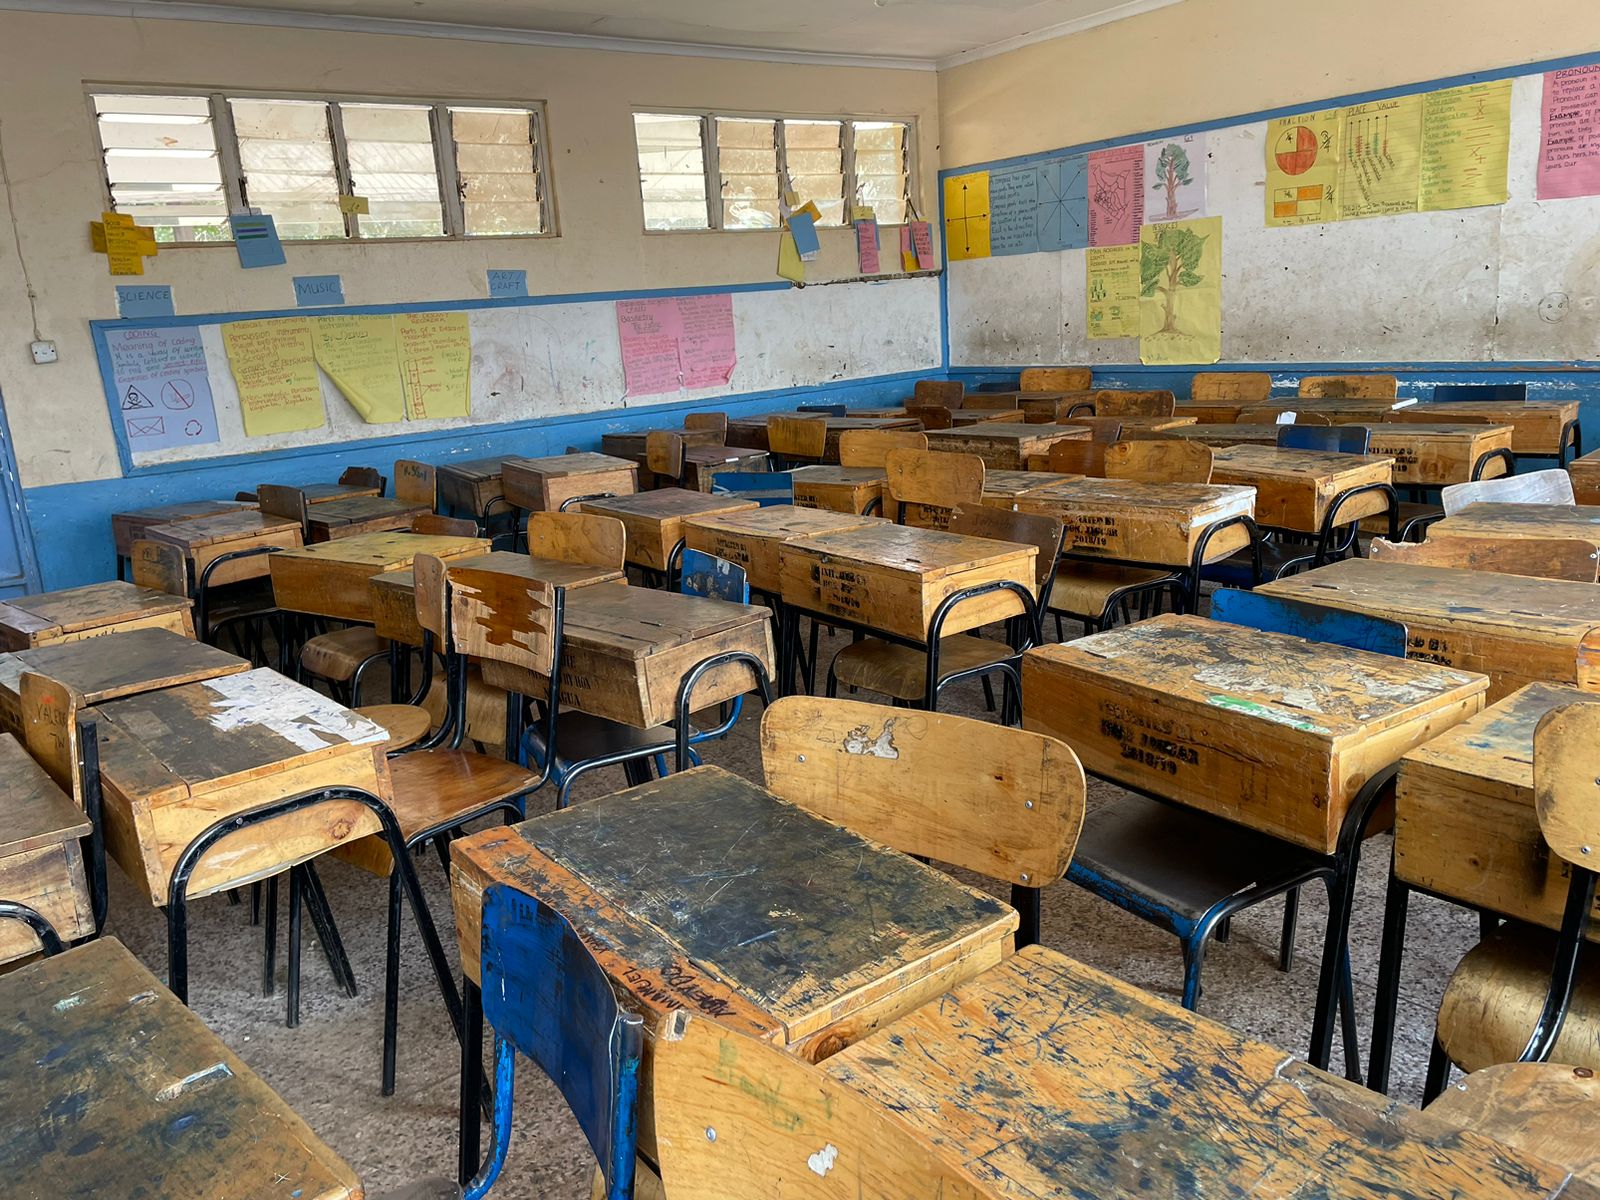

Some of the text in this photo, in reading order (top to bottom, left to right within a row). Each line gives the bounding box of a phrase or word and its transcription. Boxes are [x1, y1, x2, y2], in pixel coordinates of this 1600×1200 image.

[1561, 77, 1587, 86] pronoun
[1562, 86, 1585, 95] replace
[1553, 94, 1580, 104] Pronoun
[1348, 105, 1367, 116] PLACE
[1376, 101, 1399, 110] VALUE
[1561, 100, 1597, 111] possessive
[1279, 114, 1316, 126] FRACTION
[1549, 120, 1576, 130] pronouns
[1547, 146, 1573, 155] pronouns
[1545, 163, 1562, 172] yours
[298, 282, 337, 295] MUSIC
[490, 282, 521, 290] CRAFT
[118, 290, 169, 303] SCIENCE
[123, 329, 158, 340] CODING
[400, 327, 416, 336] Parts
[112, 342, 153, 353] Meaning
[158, 340, 167, 348] of
[1072, 535, 1107, 546] 2018/19
